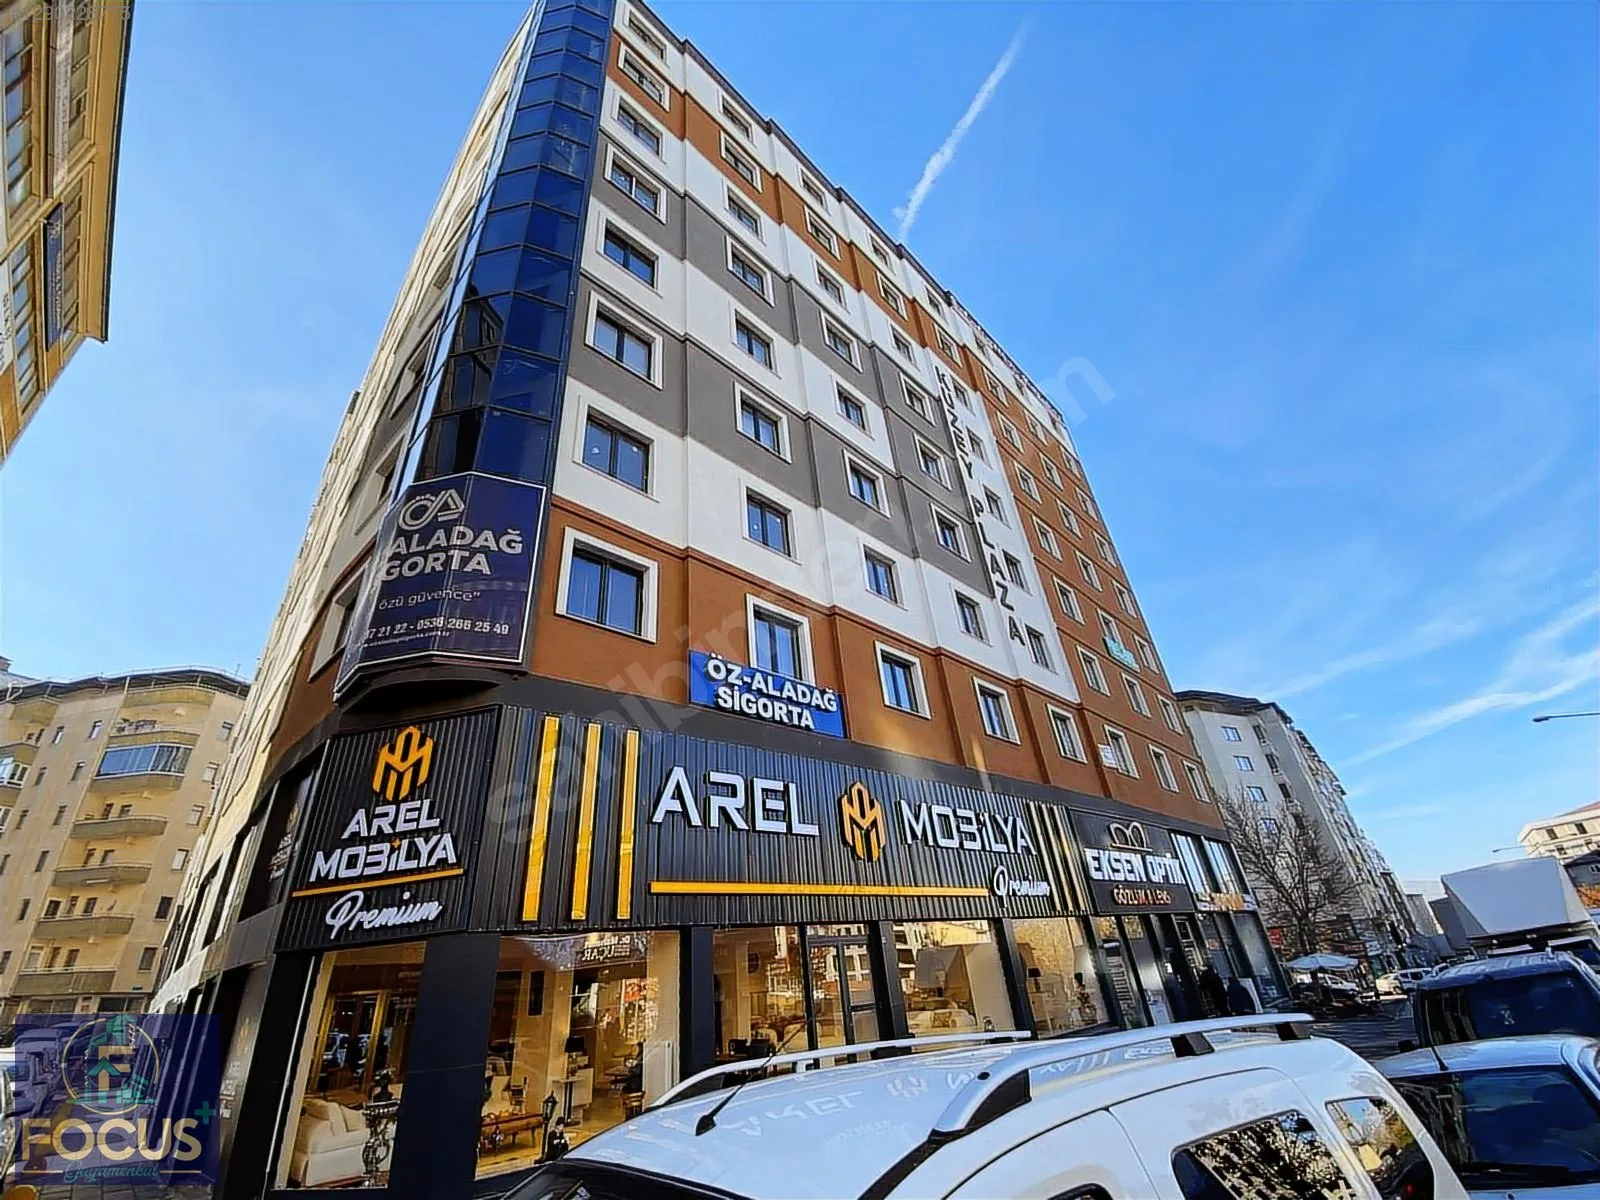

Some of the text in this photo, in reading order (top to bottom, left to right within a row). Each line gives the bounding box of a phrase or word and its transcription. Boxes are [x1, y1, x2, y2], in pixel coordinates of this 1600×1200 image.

[934, 365, 974, 480] KUZEY
[388, 526, 523, 557] ALADAĞ
[970, 494, 1025, 647] PLAZA
[474, 620, 490, 633] 25
[707, 652, 838, 713] ÖZ-ALADAĞ
[717, 682, 815, 730] SİGORTA
[342, 798, 441, 839] AREL
[652, 766, 819, 837] AREL
[1084, 847, 1187, 885] EKSEN OPTİK
[325, 889, 443, 940] Premium
